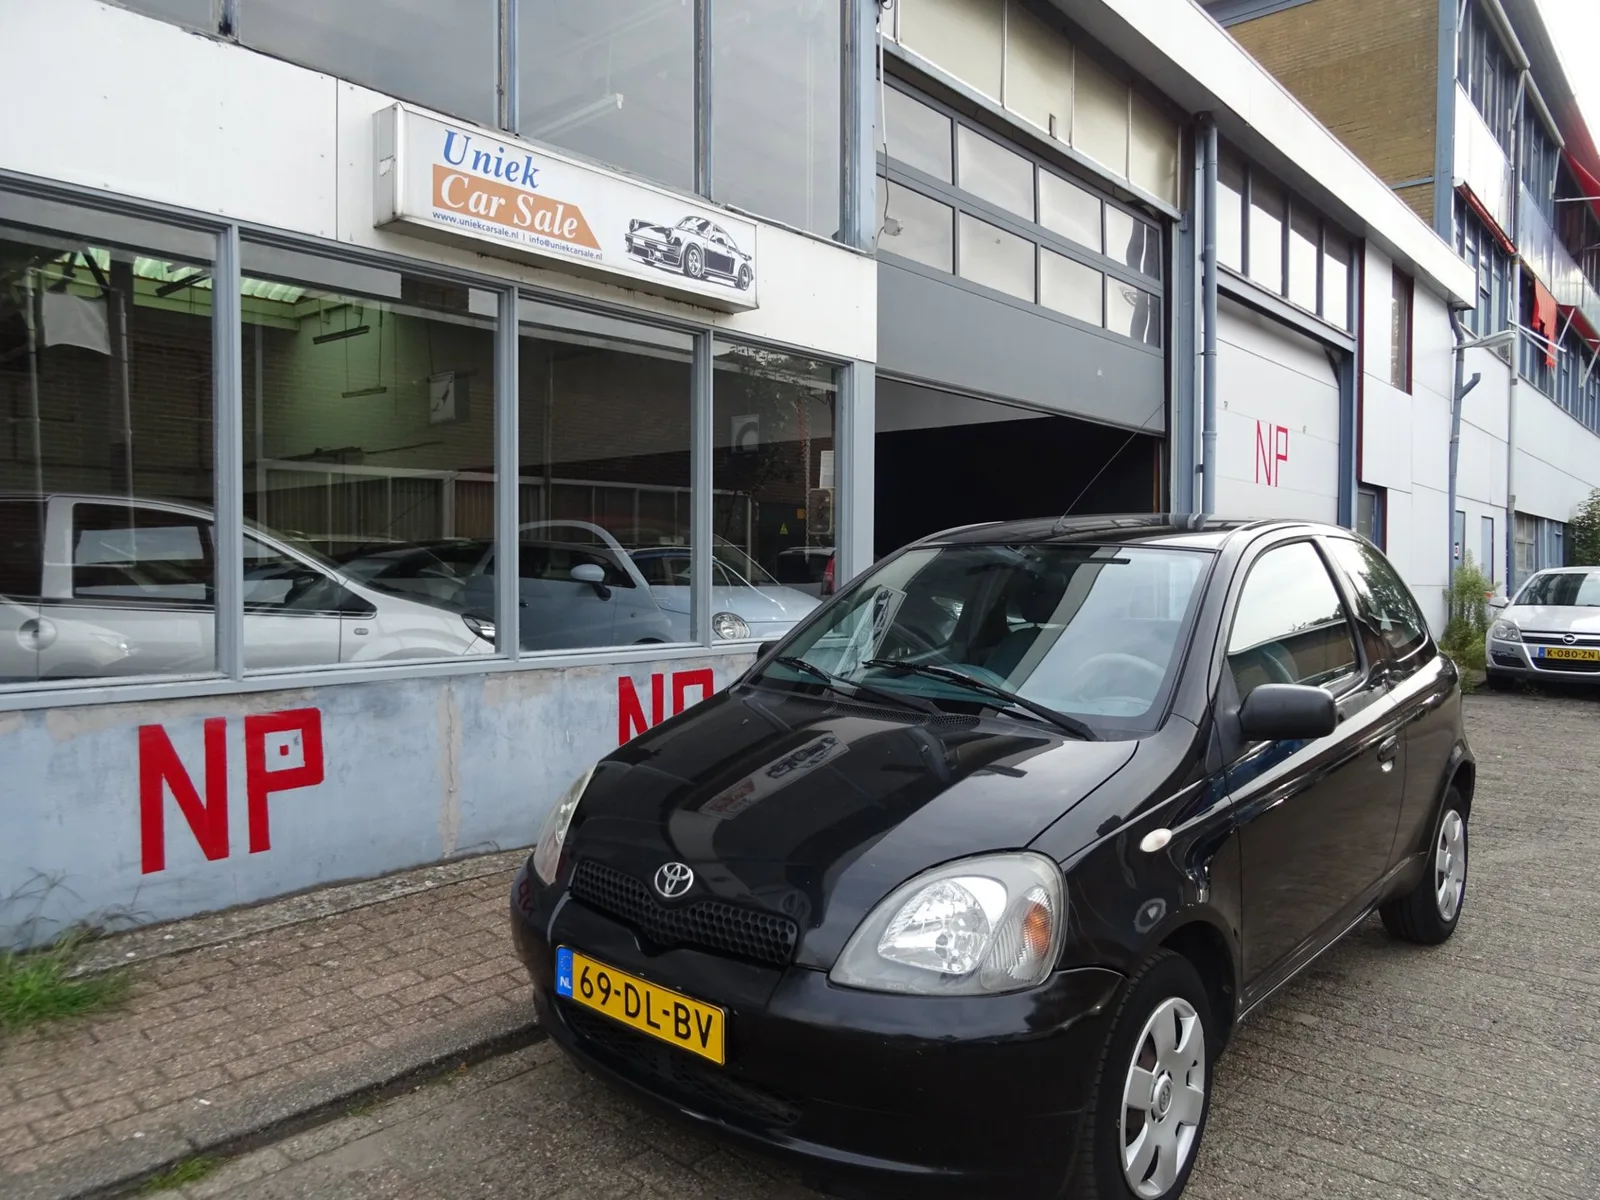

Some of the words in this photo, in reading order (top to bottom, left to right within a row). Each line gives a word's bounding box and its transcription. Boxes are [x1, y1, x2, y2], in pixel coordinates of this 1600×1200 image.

[443, 129, 540, 189] Uniek
[432, 211, 519, 240] www.uniekcarsale.nl
[529, 236, 603, 261] info@uniekcarsale.nl
[441, 174, 506, 218] Car
[513, 193, 578, 239] Sale
[1255, 419, 1289, 488] NP
[1546, 648, 1596, 659] K-080-ZN
[137, 707, 325, 875] NP
[559, 975, 572, 990] NL
[580, 965, 713, 1049] 69-DL-BV
